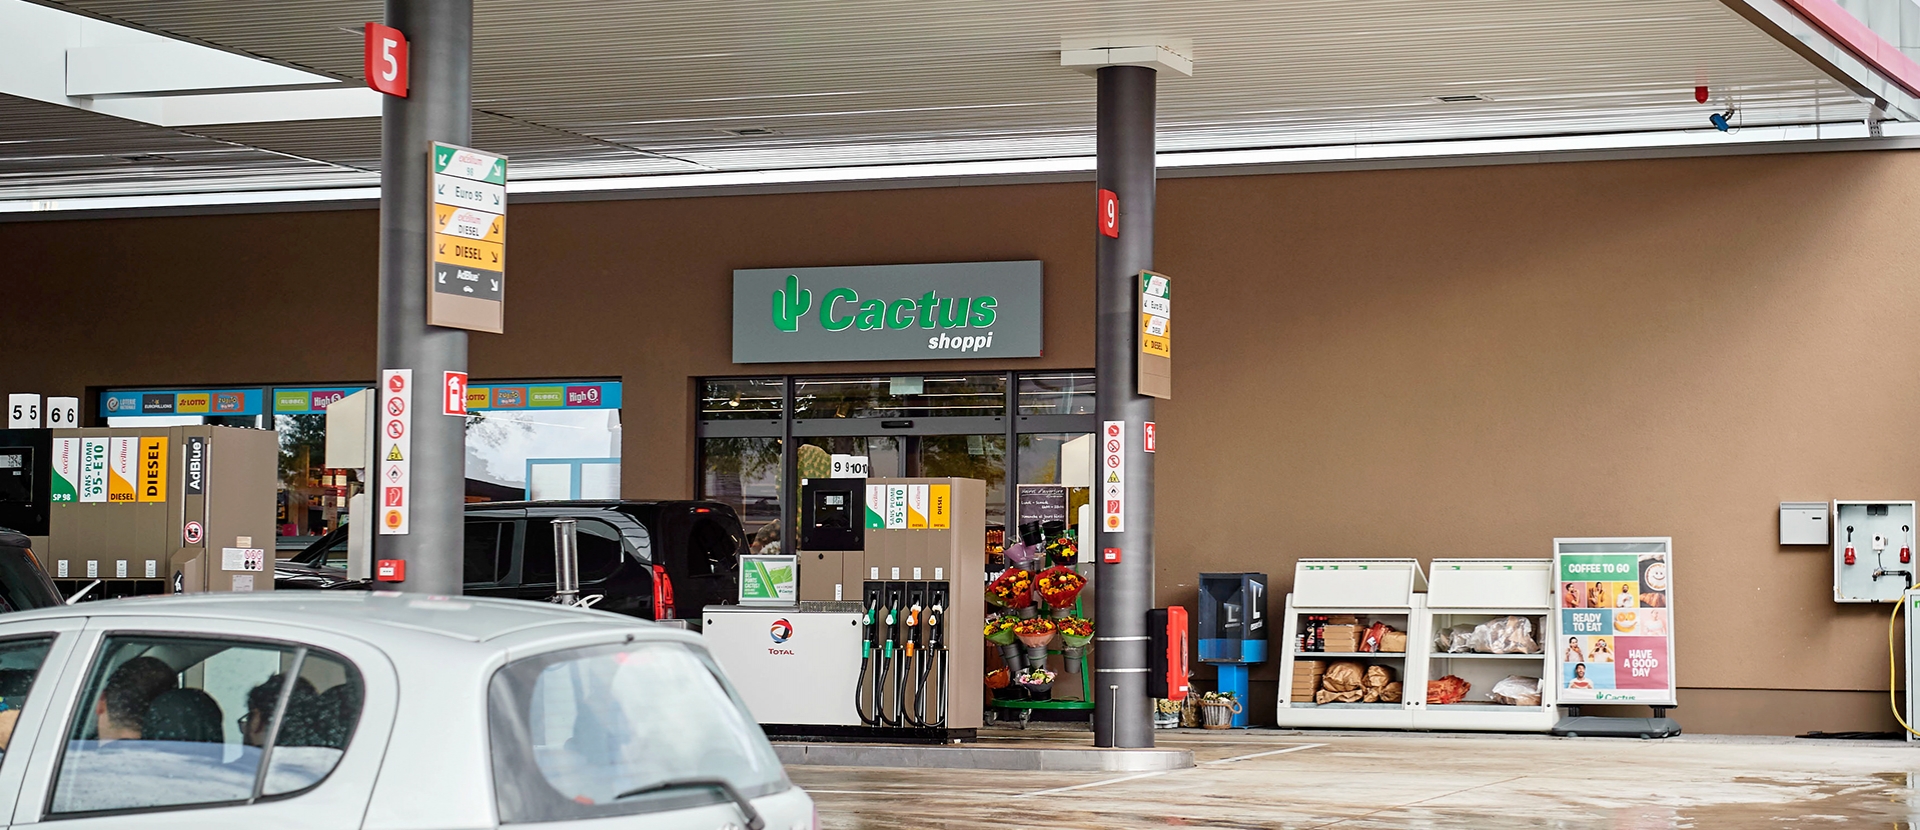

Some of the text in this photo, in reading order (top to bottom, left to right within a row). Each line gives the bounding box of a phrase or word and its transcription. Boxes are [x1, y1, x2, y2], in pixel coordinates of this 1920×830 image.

[382, 37, 398, 82] 5
[456, 186, 482, 202] Euro 95
[1107, 198, 1115, 229] 9
[458, 224, 479, 237] DIESEL
[456, 245, 482, 260] DIESEL
[819, 287, 998, 332] Cactus
[928, 332, 994, 352] shoppi
[314, 396, 330, 408] High
[569, 391, 586, 403] High
[13, 405, 37, 420] 5 5
[51, 408, 74, 423] 6 6
[92, 445, 104, 494] 95-E10
[147, 442, 159, 496] DIESEL
[834, 462, 849, 472] 9 9
[851, 463, 861, 474] 10
[1568, 564, 1630, 573] COFFEE TO GO
[1573, 613, 1602, 622] READY
[1573, 623, 1602, 632] TO EAT
[1629, 650, 1652, 658] HAVE
[1624, 659, 1658, 668] A GOOD
[1632, 668, 1650, 677] DAY
